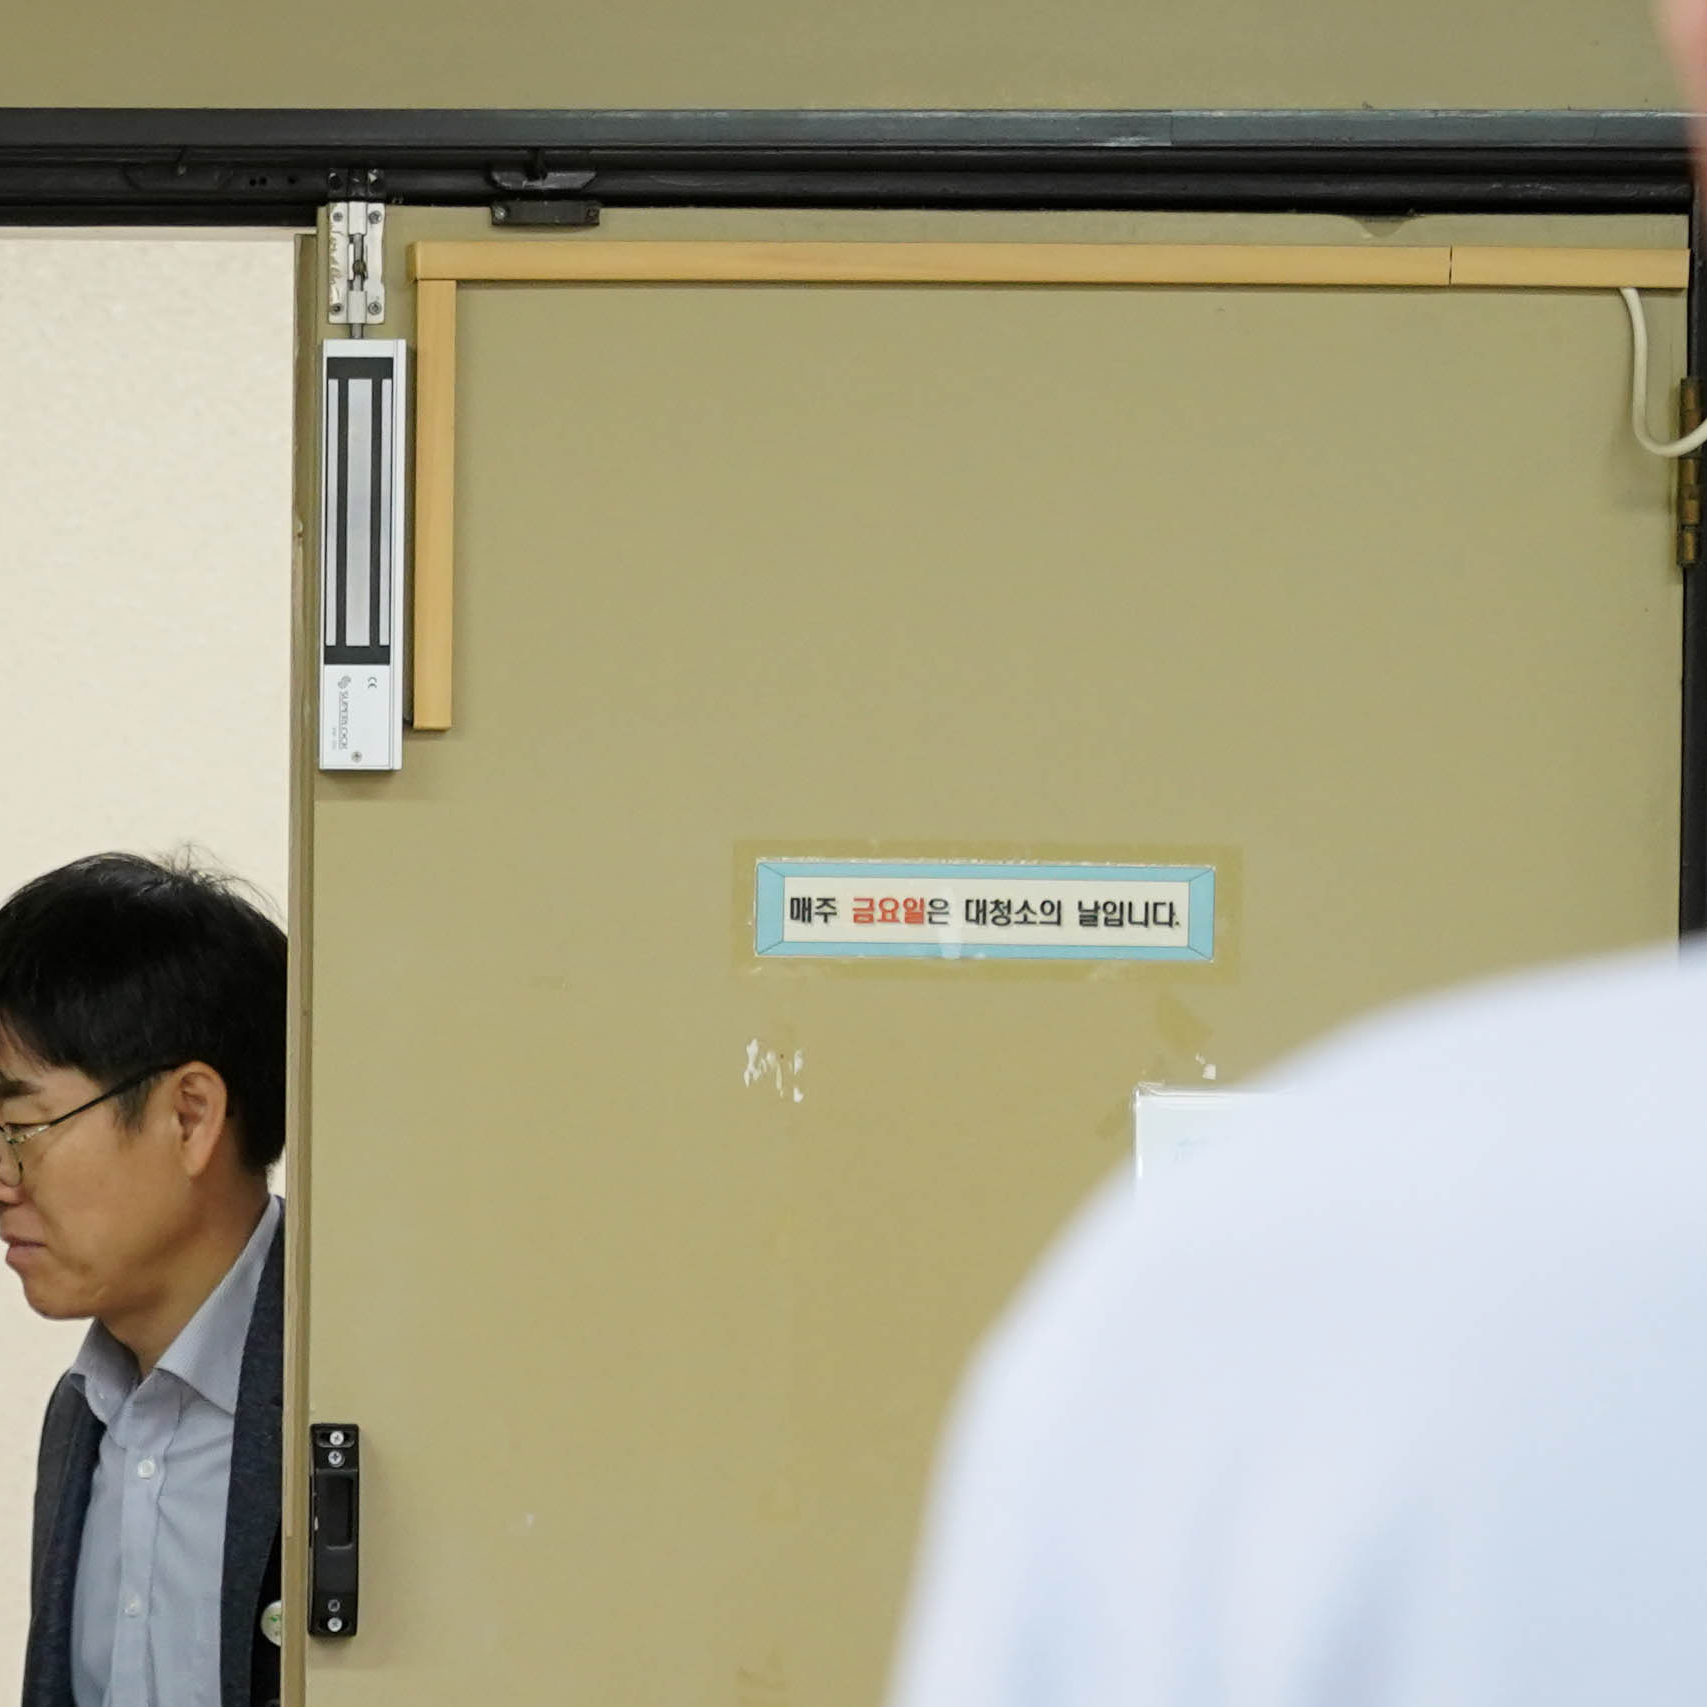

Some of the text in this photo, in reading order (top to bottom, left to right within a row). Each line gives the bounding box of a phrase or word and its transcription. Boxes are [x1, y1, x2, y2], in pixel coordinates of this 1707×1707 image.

[789, 896, 1182, 929] 매주 금요일은 대청소의 날입니다.
